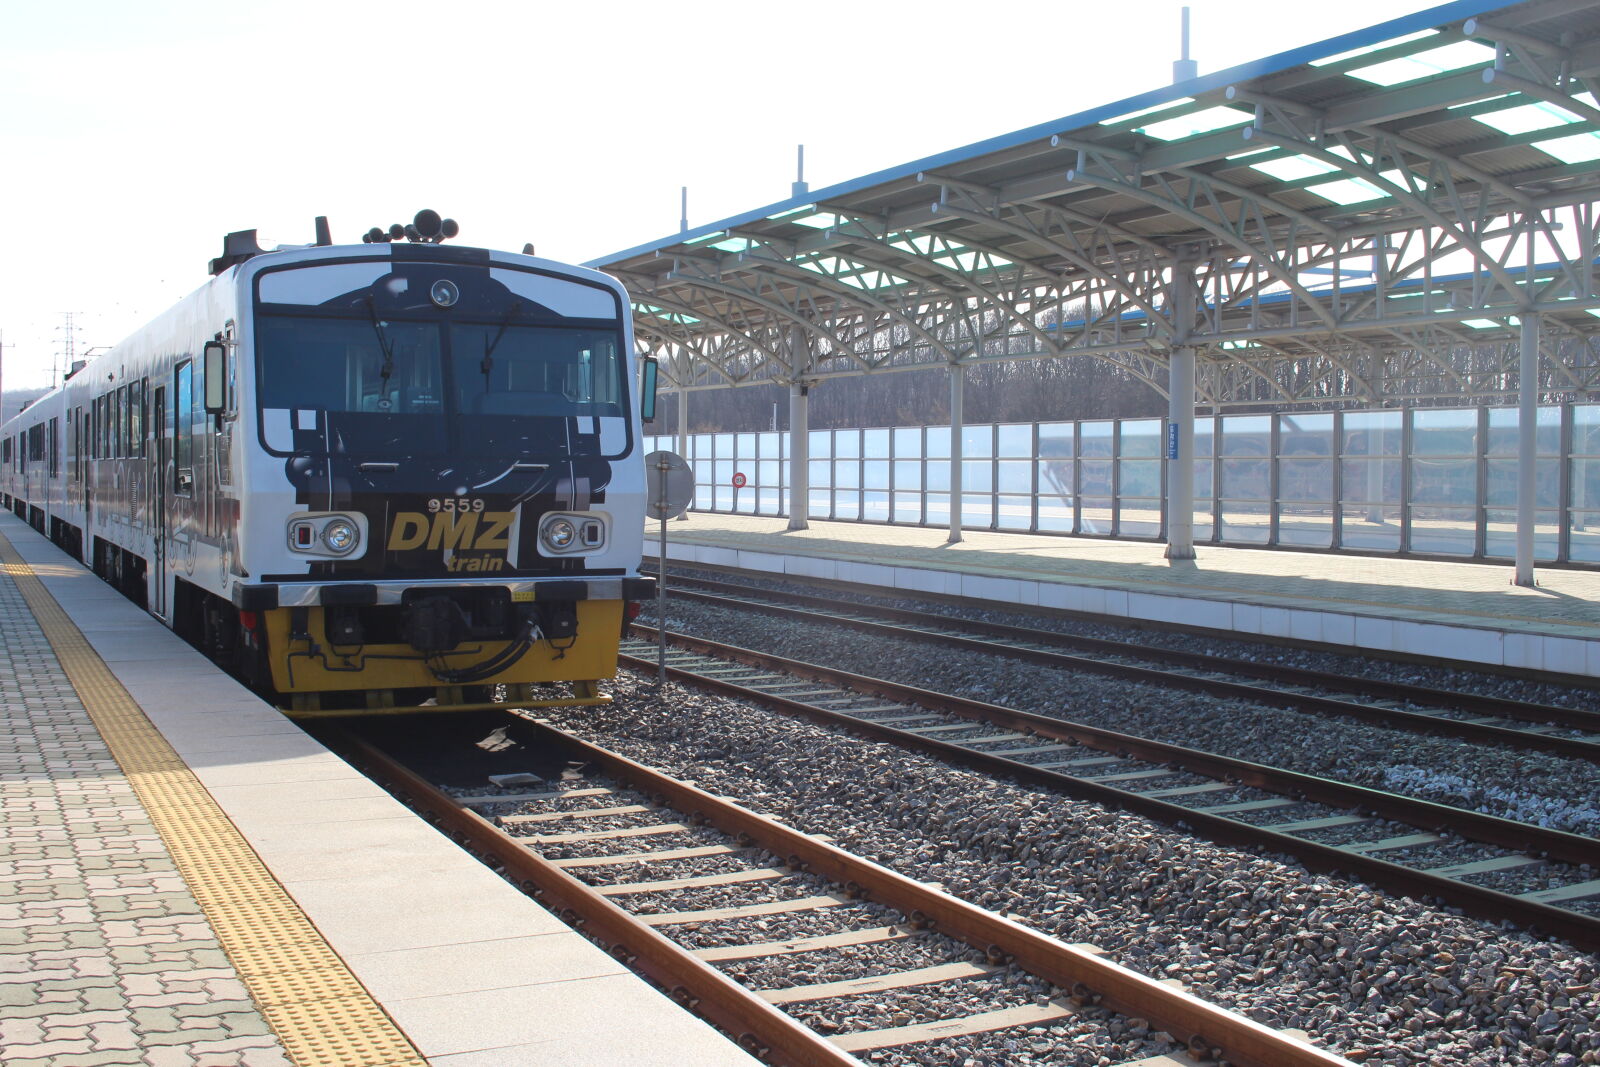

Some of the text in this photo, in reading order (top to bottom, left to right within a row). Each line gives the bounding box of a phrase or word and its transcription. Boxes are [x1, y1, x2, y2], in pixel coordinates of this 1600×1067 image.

[428, 499, 485, 512] 9559
[387, 512, 516, 550] DMZ
[447, 554, 503, 572] train
